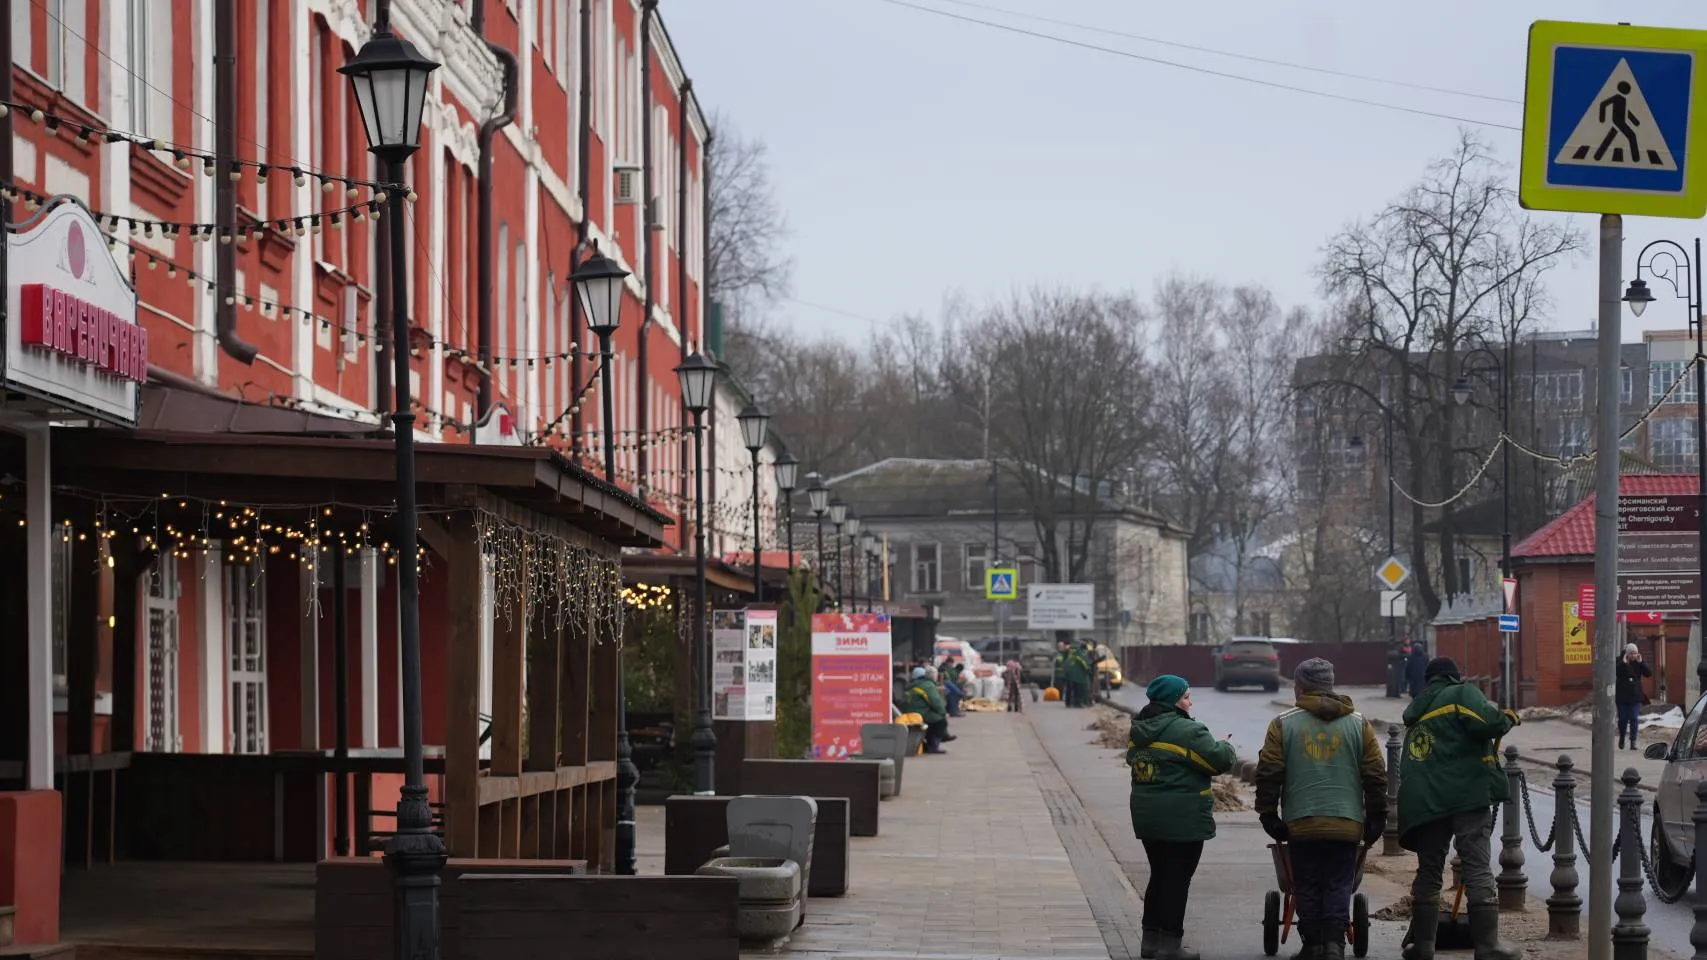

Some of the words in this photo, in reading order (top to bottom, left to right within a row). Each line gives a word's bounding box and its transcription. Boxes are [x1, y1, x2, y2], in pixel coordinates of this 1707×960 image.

[42, 283, 147, 384] ВАРЕНИЧНАЯ
[1617, 497, 1668, 506] ефсиманский
[1617, 505, 1665, 513] ерниговский
[1628, 515, 1675, 523] Chernigovsky
[835, 636, 868, 646] ЗИМА
[860, 673, 885, 682] ЭТАЖ
